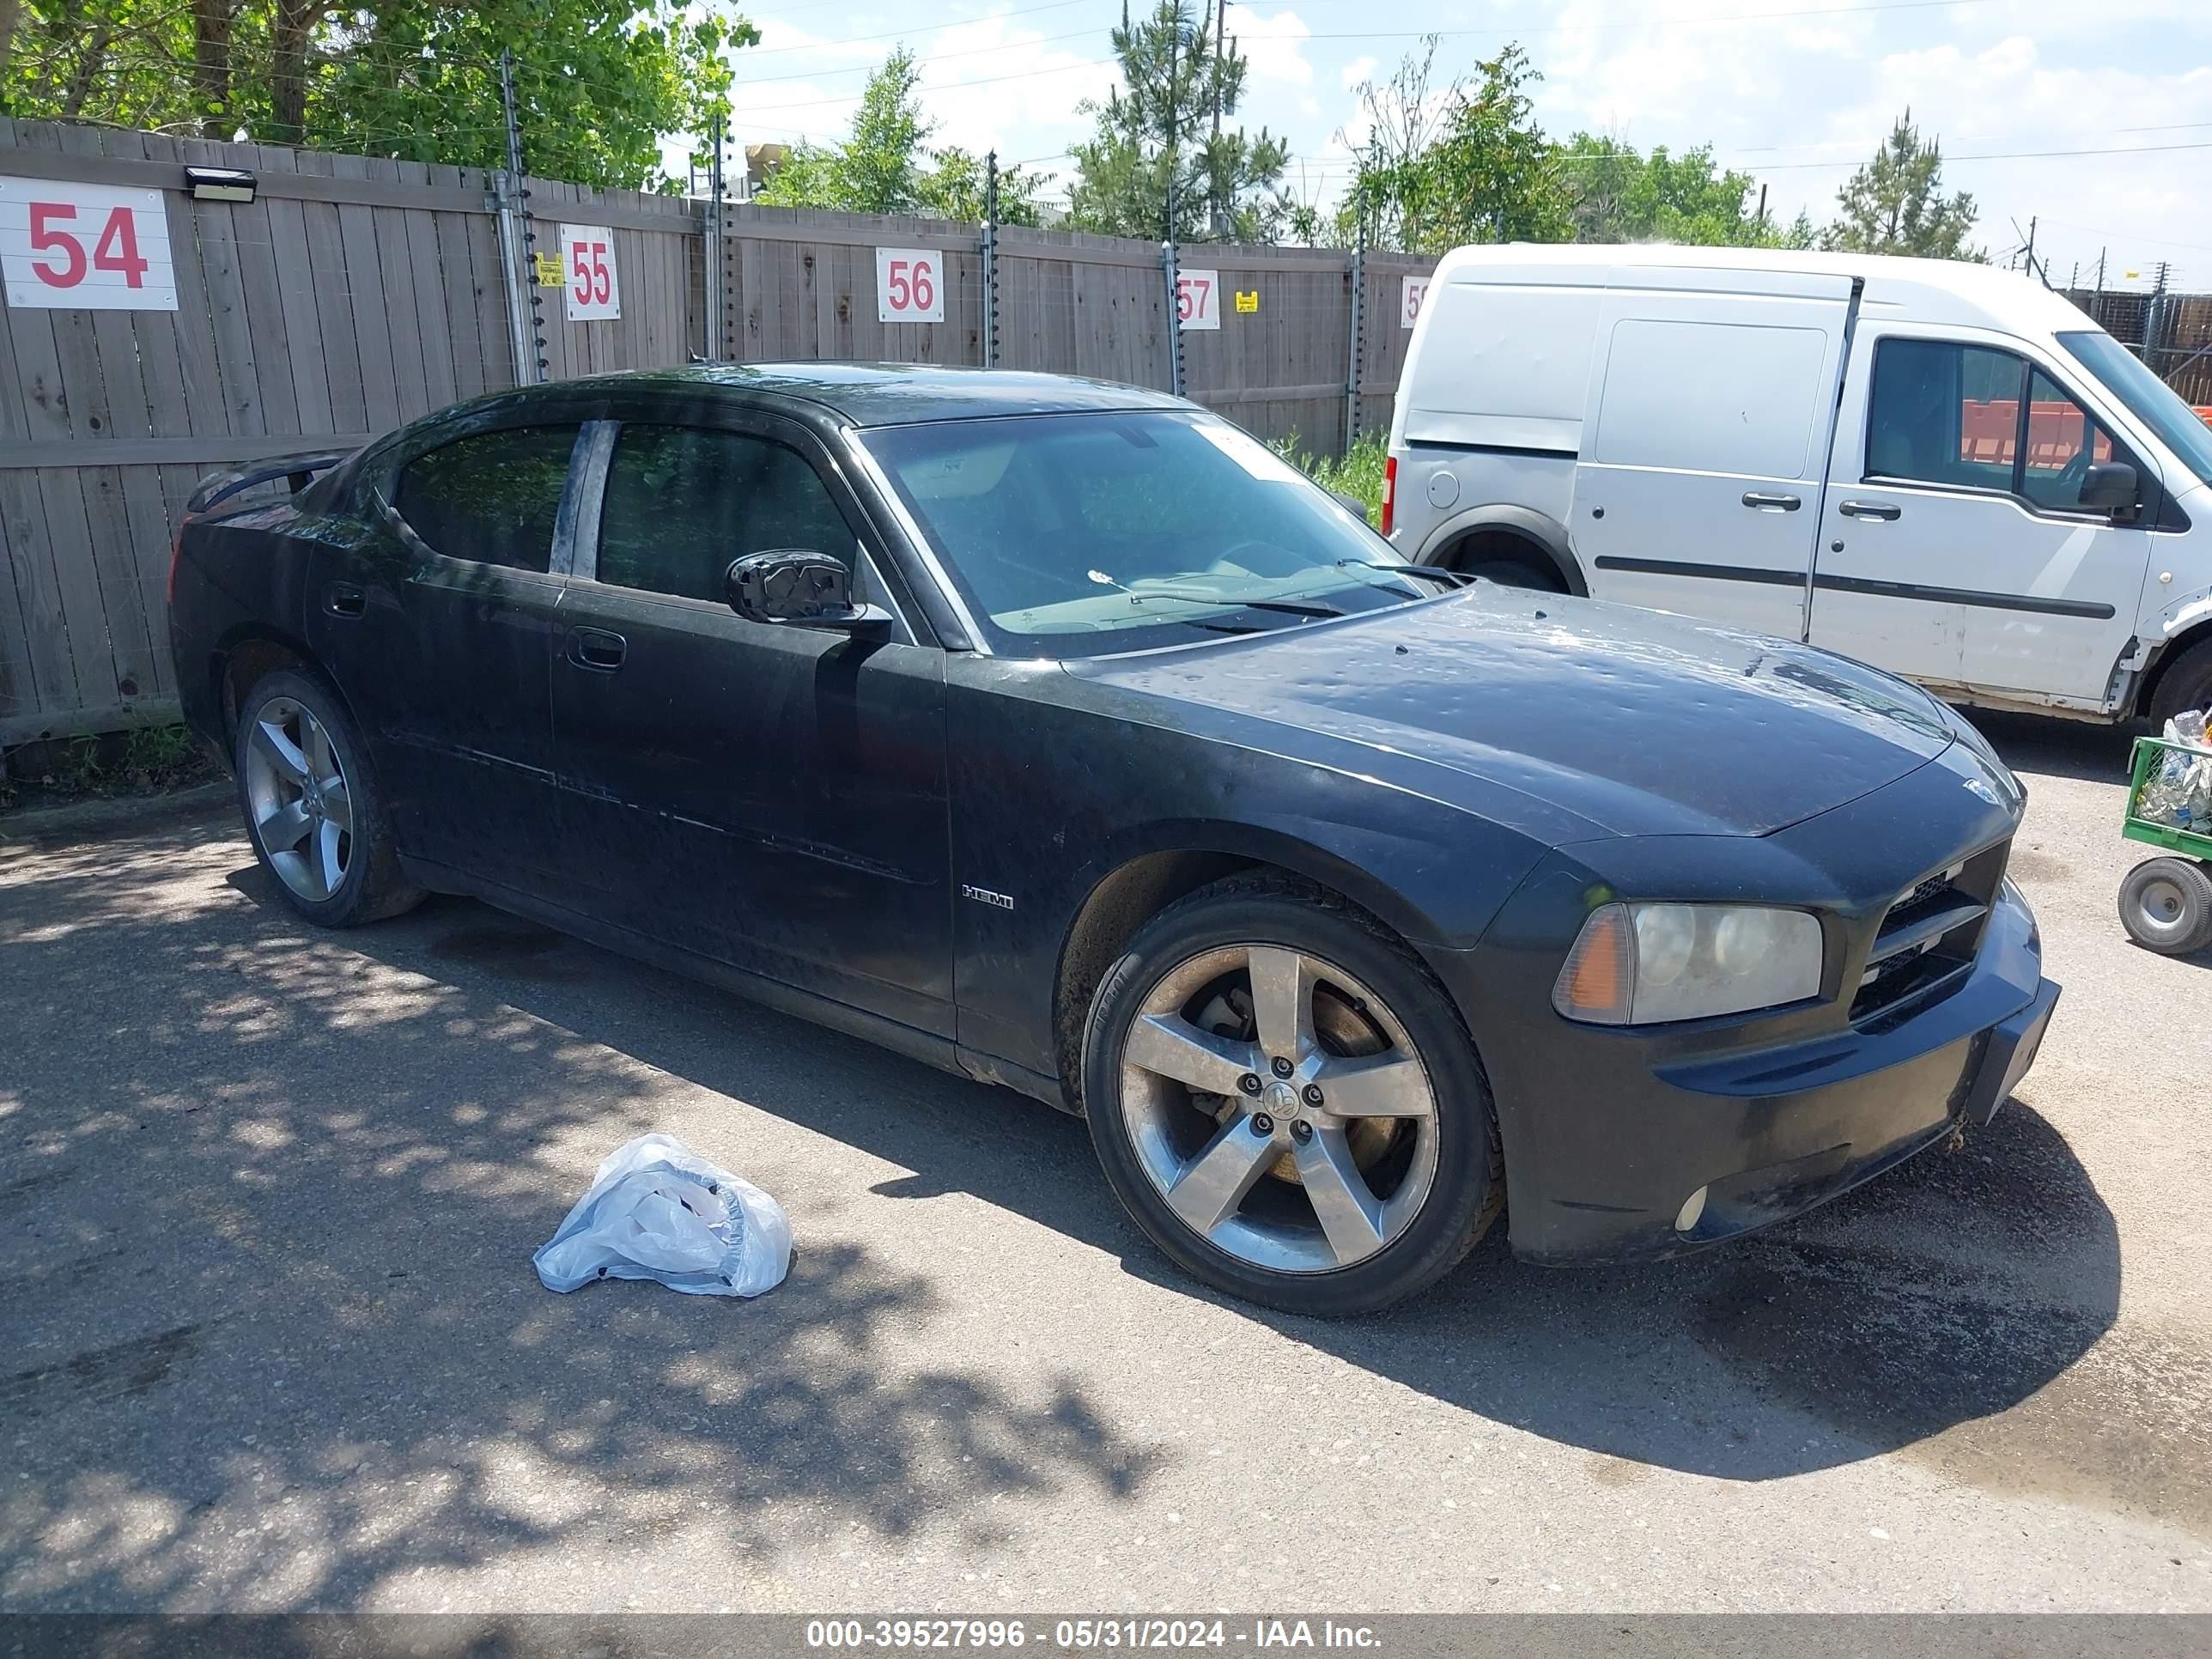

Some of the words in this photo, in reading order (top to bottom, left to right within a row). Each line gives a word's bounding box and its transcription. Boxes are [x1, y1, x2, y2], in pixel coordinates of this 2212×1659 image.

[29, 202, 148, 289] 54
[573, 242, 611, 305] 55
[889, 261, 933, 311] 56
[1177, 280, 1210, 319] 57
[962, 884, 1014, 910] HEMI
